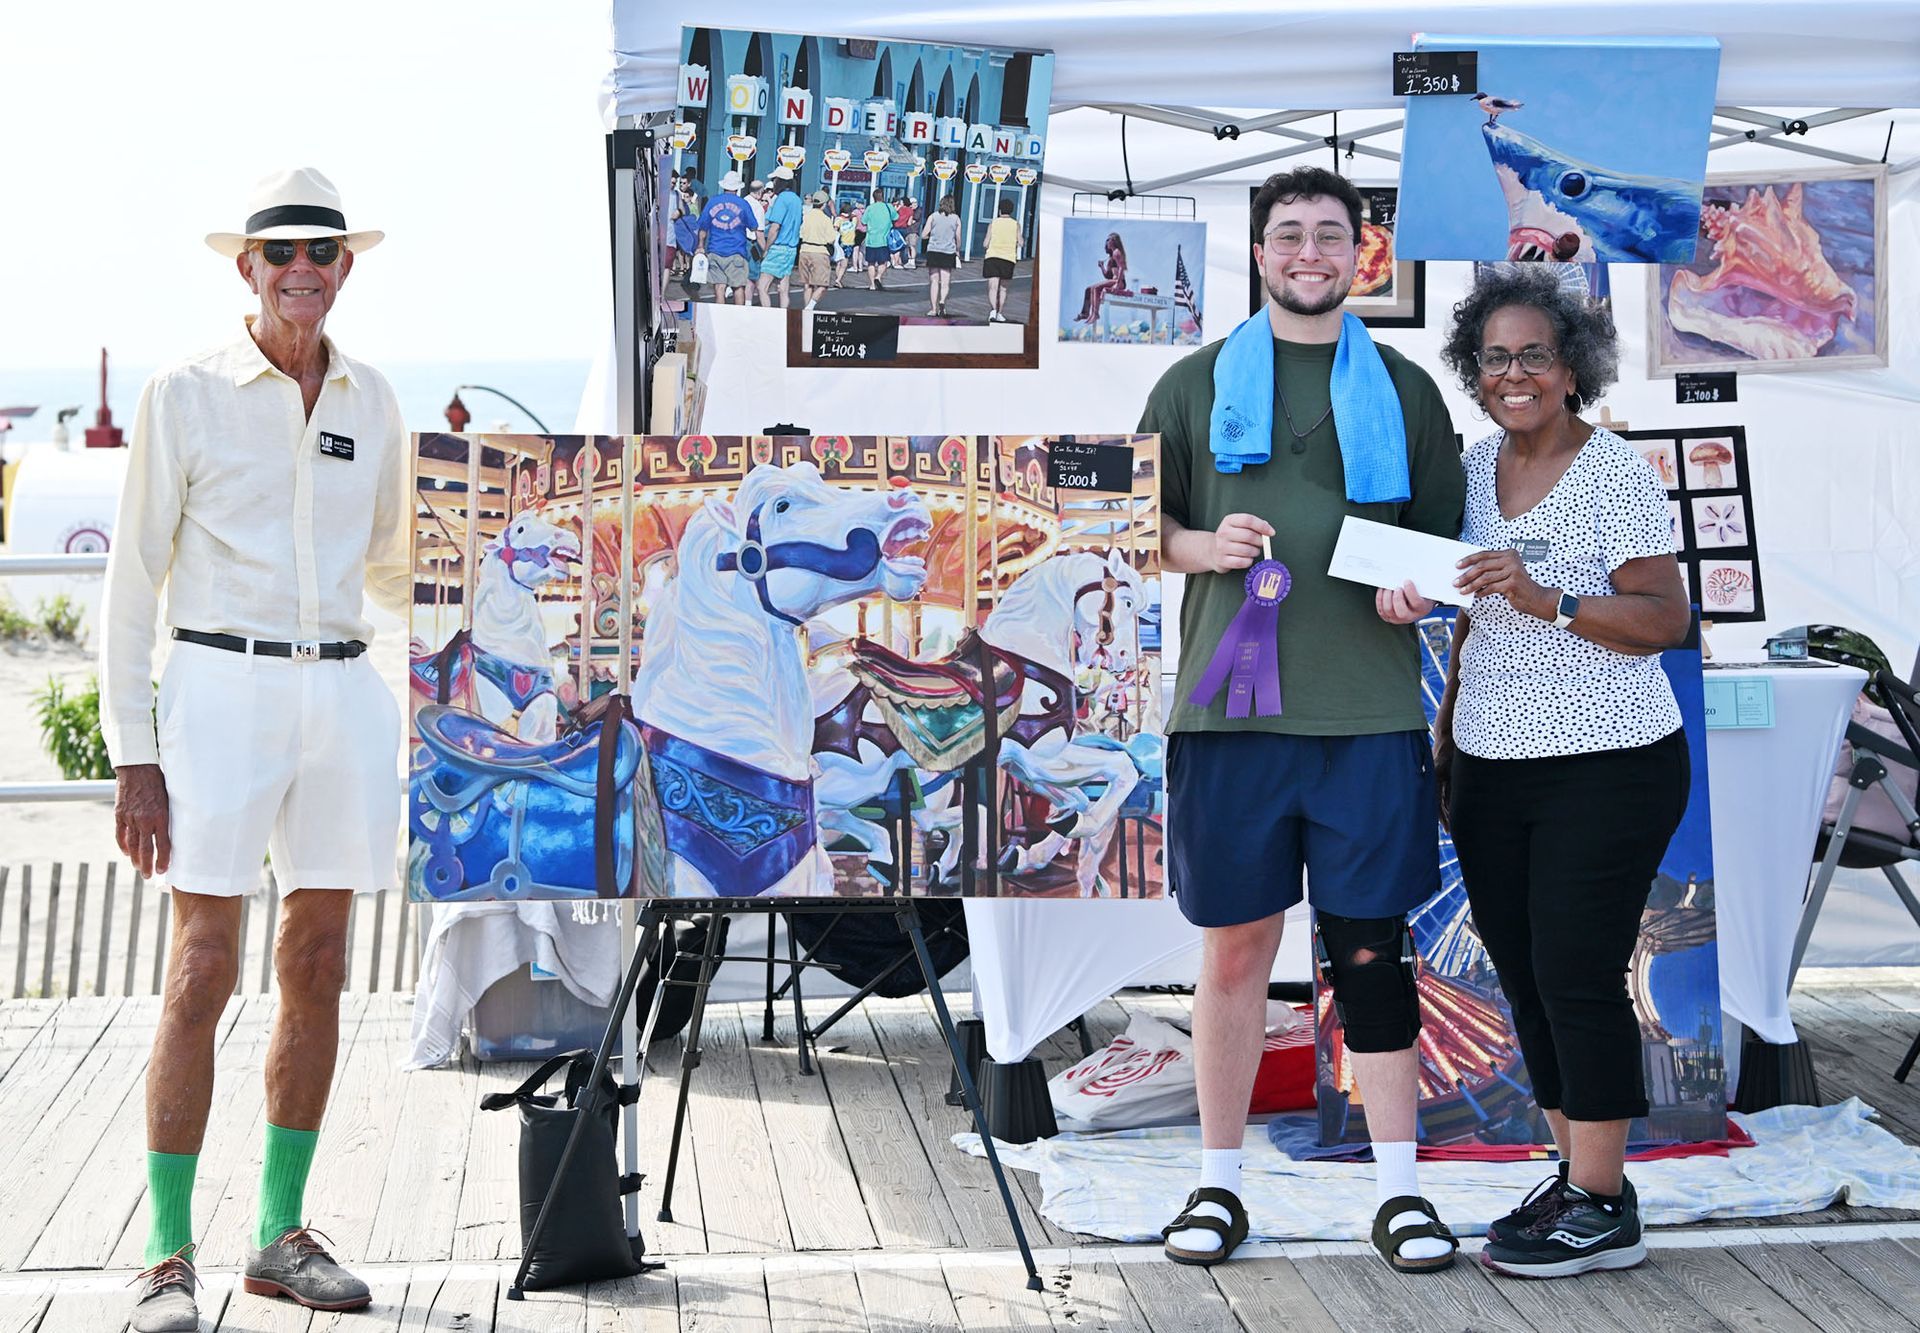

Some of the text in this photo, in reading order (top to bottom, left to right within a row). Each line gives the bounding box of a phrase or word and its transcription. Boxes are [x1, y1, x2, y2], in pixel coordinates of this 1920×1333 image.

[1403, 76, 1448, 94] 1,350
[818, 343, 855, 358] 1,400
[1059, 473, 1089, 488] 5,000
